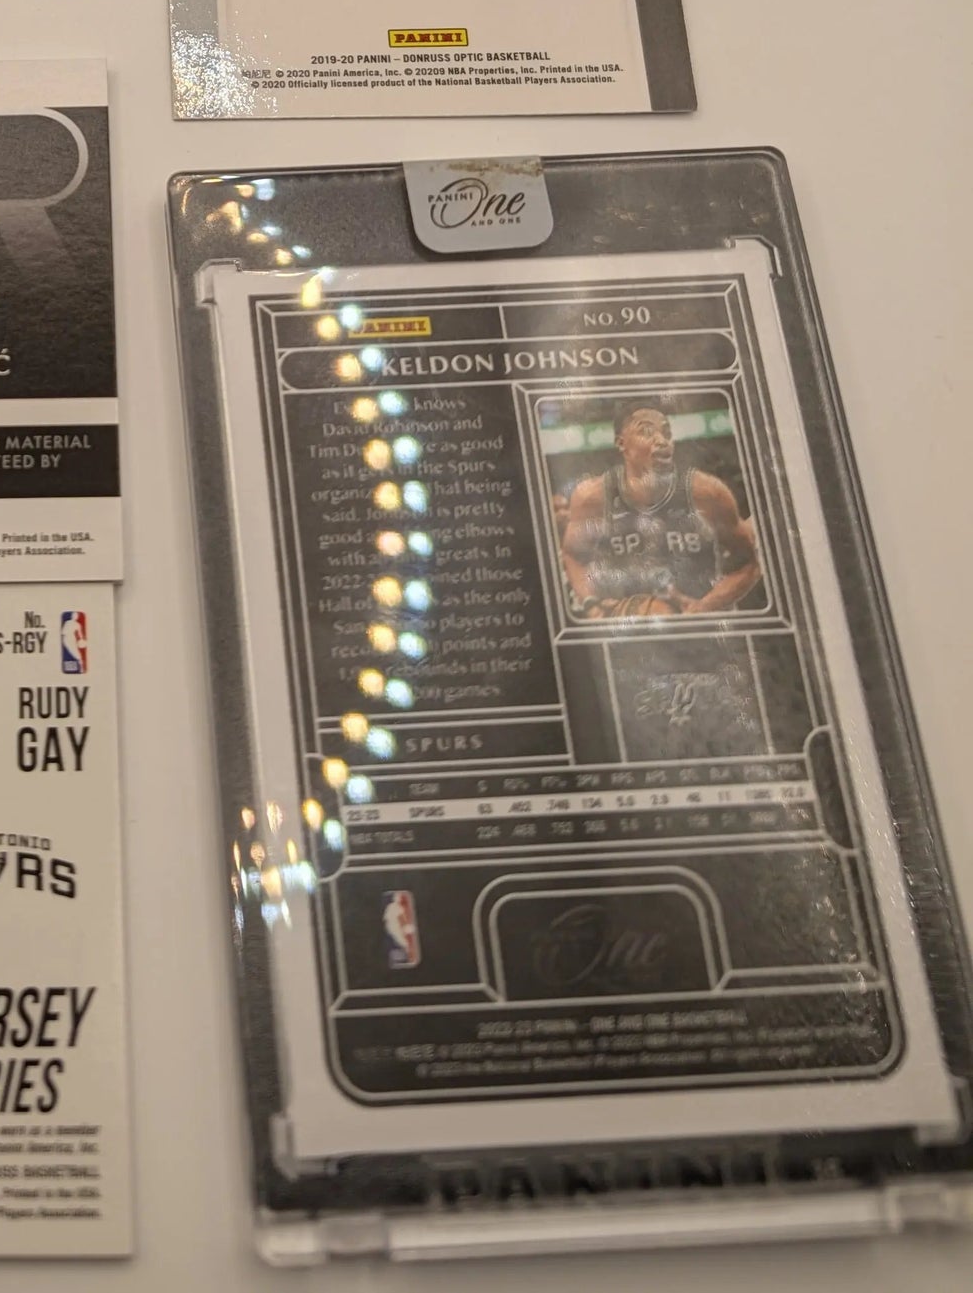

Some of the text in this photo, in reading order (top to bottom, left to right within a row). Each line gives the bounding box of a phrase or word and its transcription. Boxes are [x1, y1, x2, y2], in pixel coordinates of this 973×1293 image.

[394, 32, 463, 44] PANINI
[428, 192, 473, 203] PANINI
[430, 177, 525, 229] One
[471, 217, 521, 227] AND ONE
[583, 306, 651, 327] NO. 90
[381, 346, 639, 377] KELDON JOHNSON
[5, 435, 91, 450] MATERIAL
[24, 611, 46, 628] No.
[18, 686, 90, 719] RUDY
[17, 727, 90, 772] GAY
[405, 735, 484, 752] SPURS
